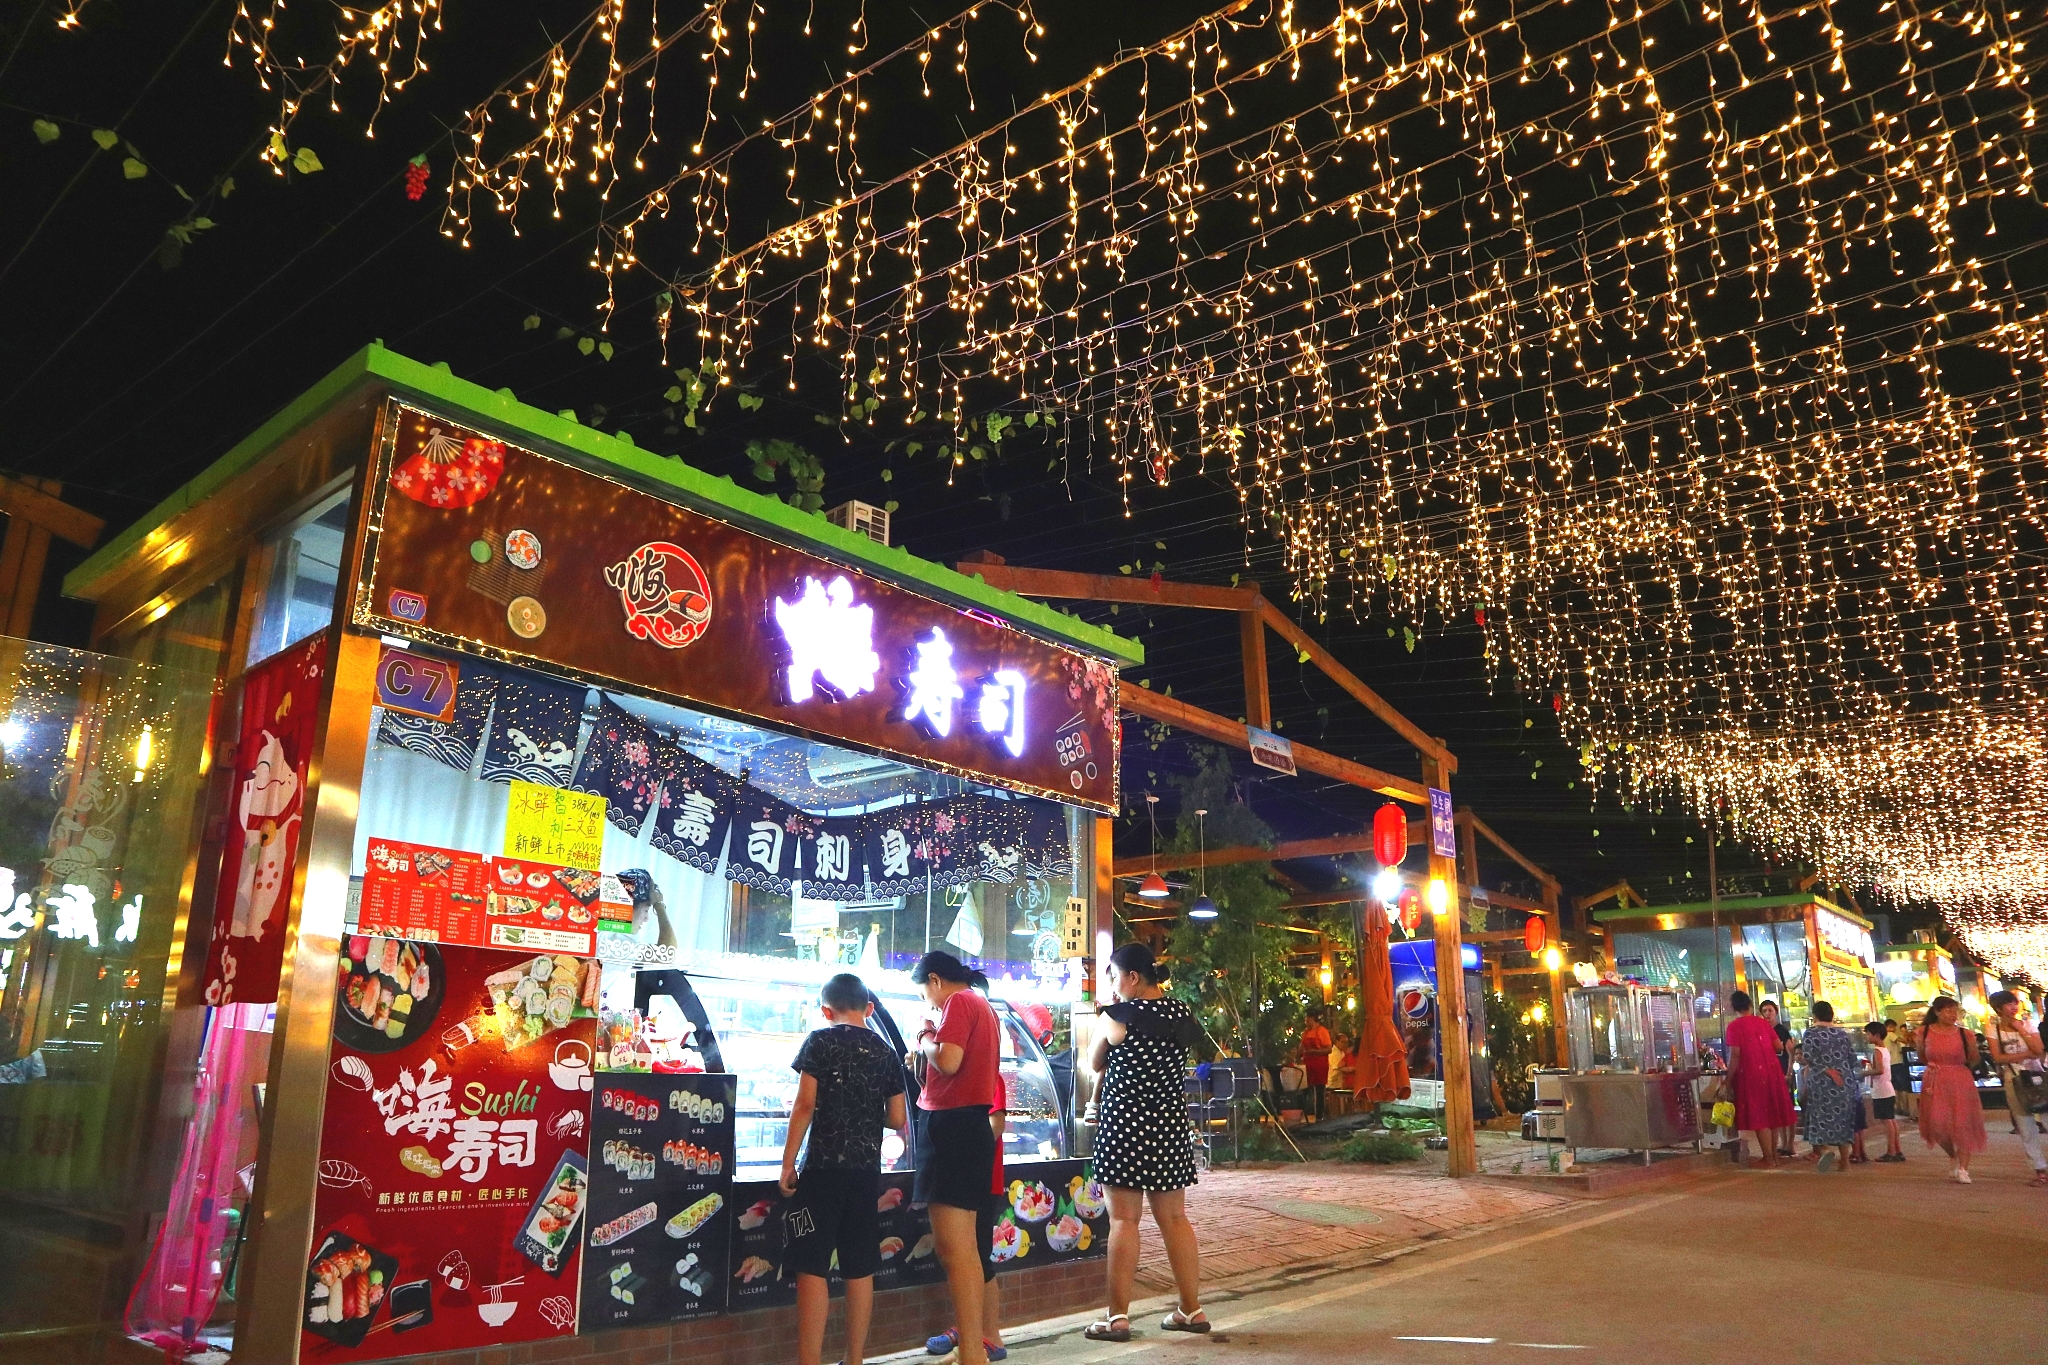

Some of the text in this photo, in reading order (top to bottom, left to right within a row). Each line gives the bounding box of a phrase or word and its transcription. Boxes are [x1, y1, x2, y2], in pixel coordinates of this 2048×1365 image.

[396, 597, 420, 616] C7
[385, 660, 443, 702] C7
[515, 832, 565, 859] 新鲜上市
[1405, 1019, 1429, 1029] pepsi
[460, 1079, 541, 1117] Sushi
